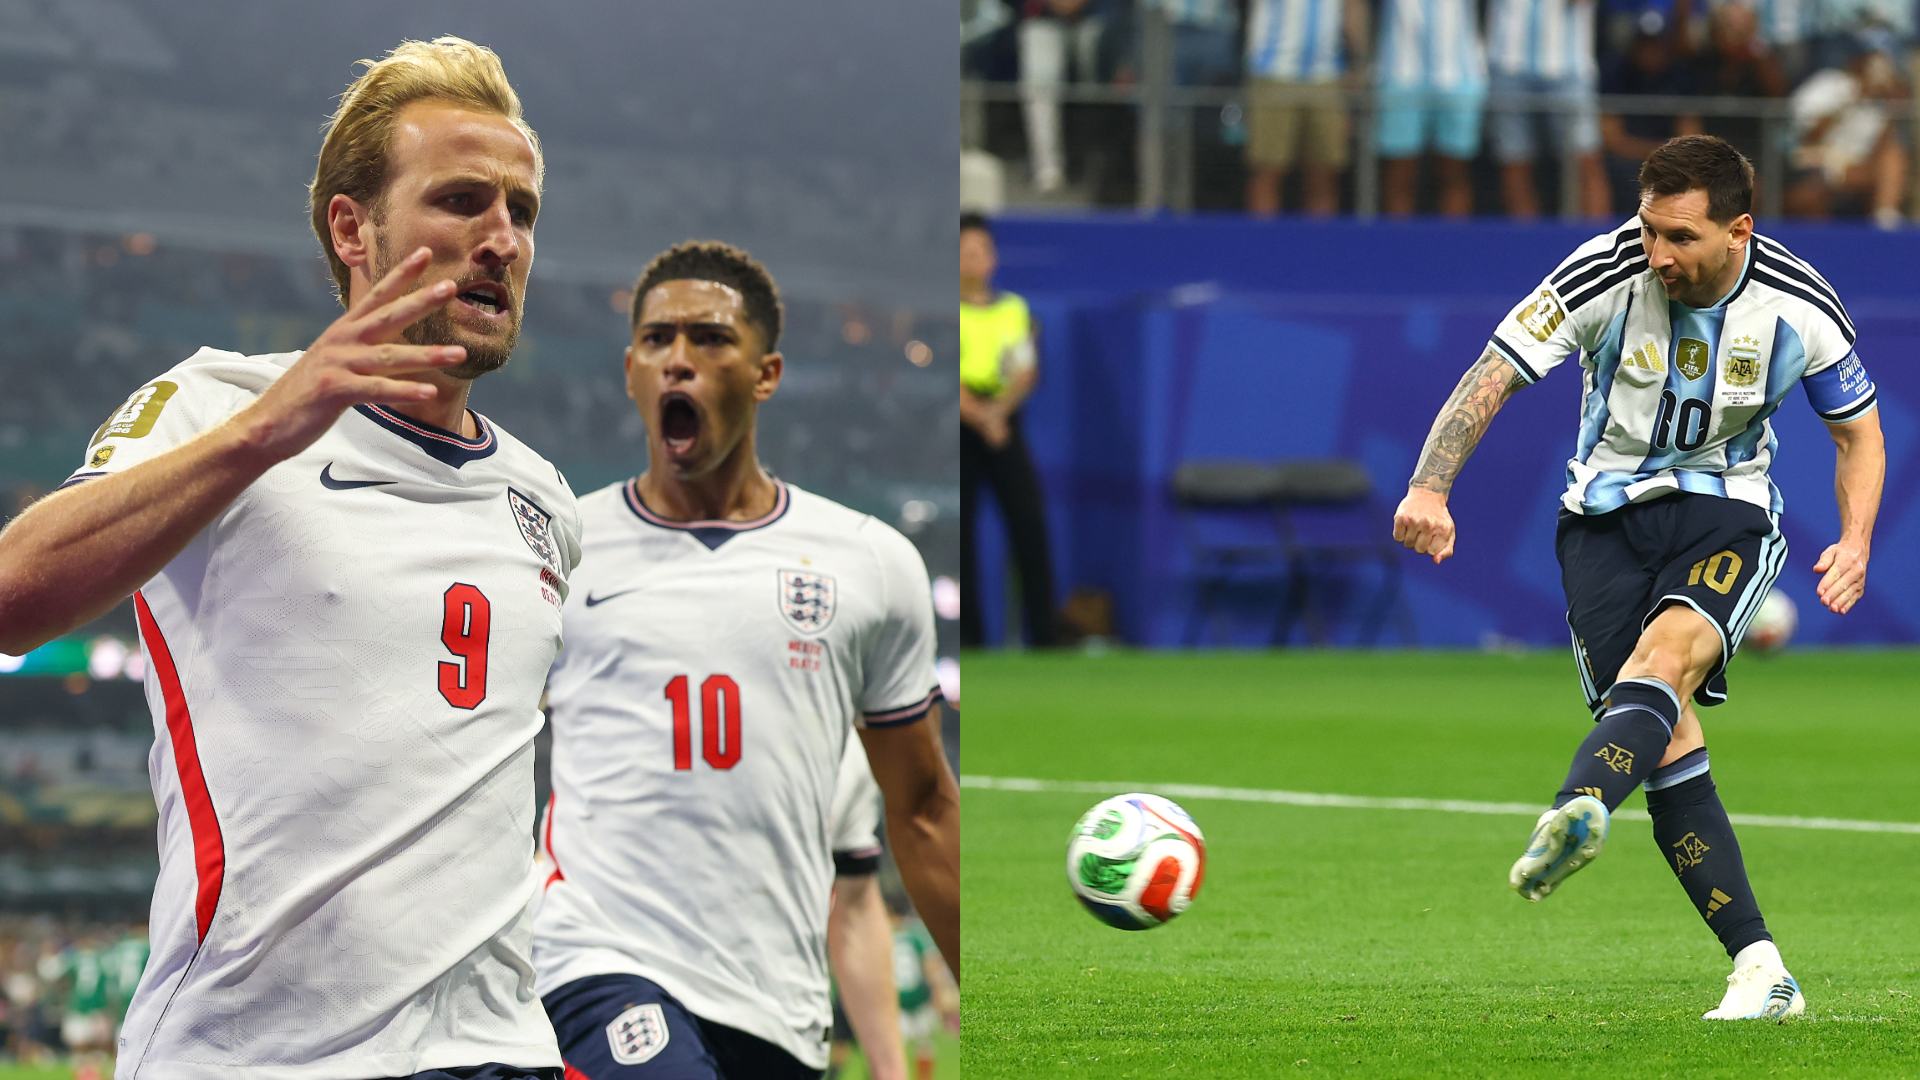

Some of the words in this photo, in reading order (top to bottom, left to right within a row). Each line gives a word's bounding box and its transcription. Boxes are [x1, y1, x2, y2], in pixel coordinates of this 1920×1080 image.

[1684, 363, 1700, 373] FIFA
[1730, 358, 1752, 377] AFA
[1656, 388, 1712, 452] 10
[1687, 549, 1743, 595] 10
[438, 581, 491, 710] 9
[664, 674, 742, 771] 10
[1594, 742, 1635, 775] AFA
[1672, 831, 1711, 874] AFA
